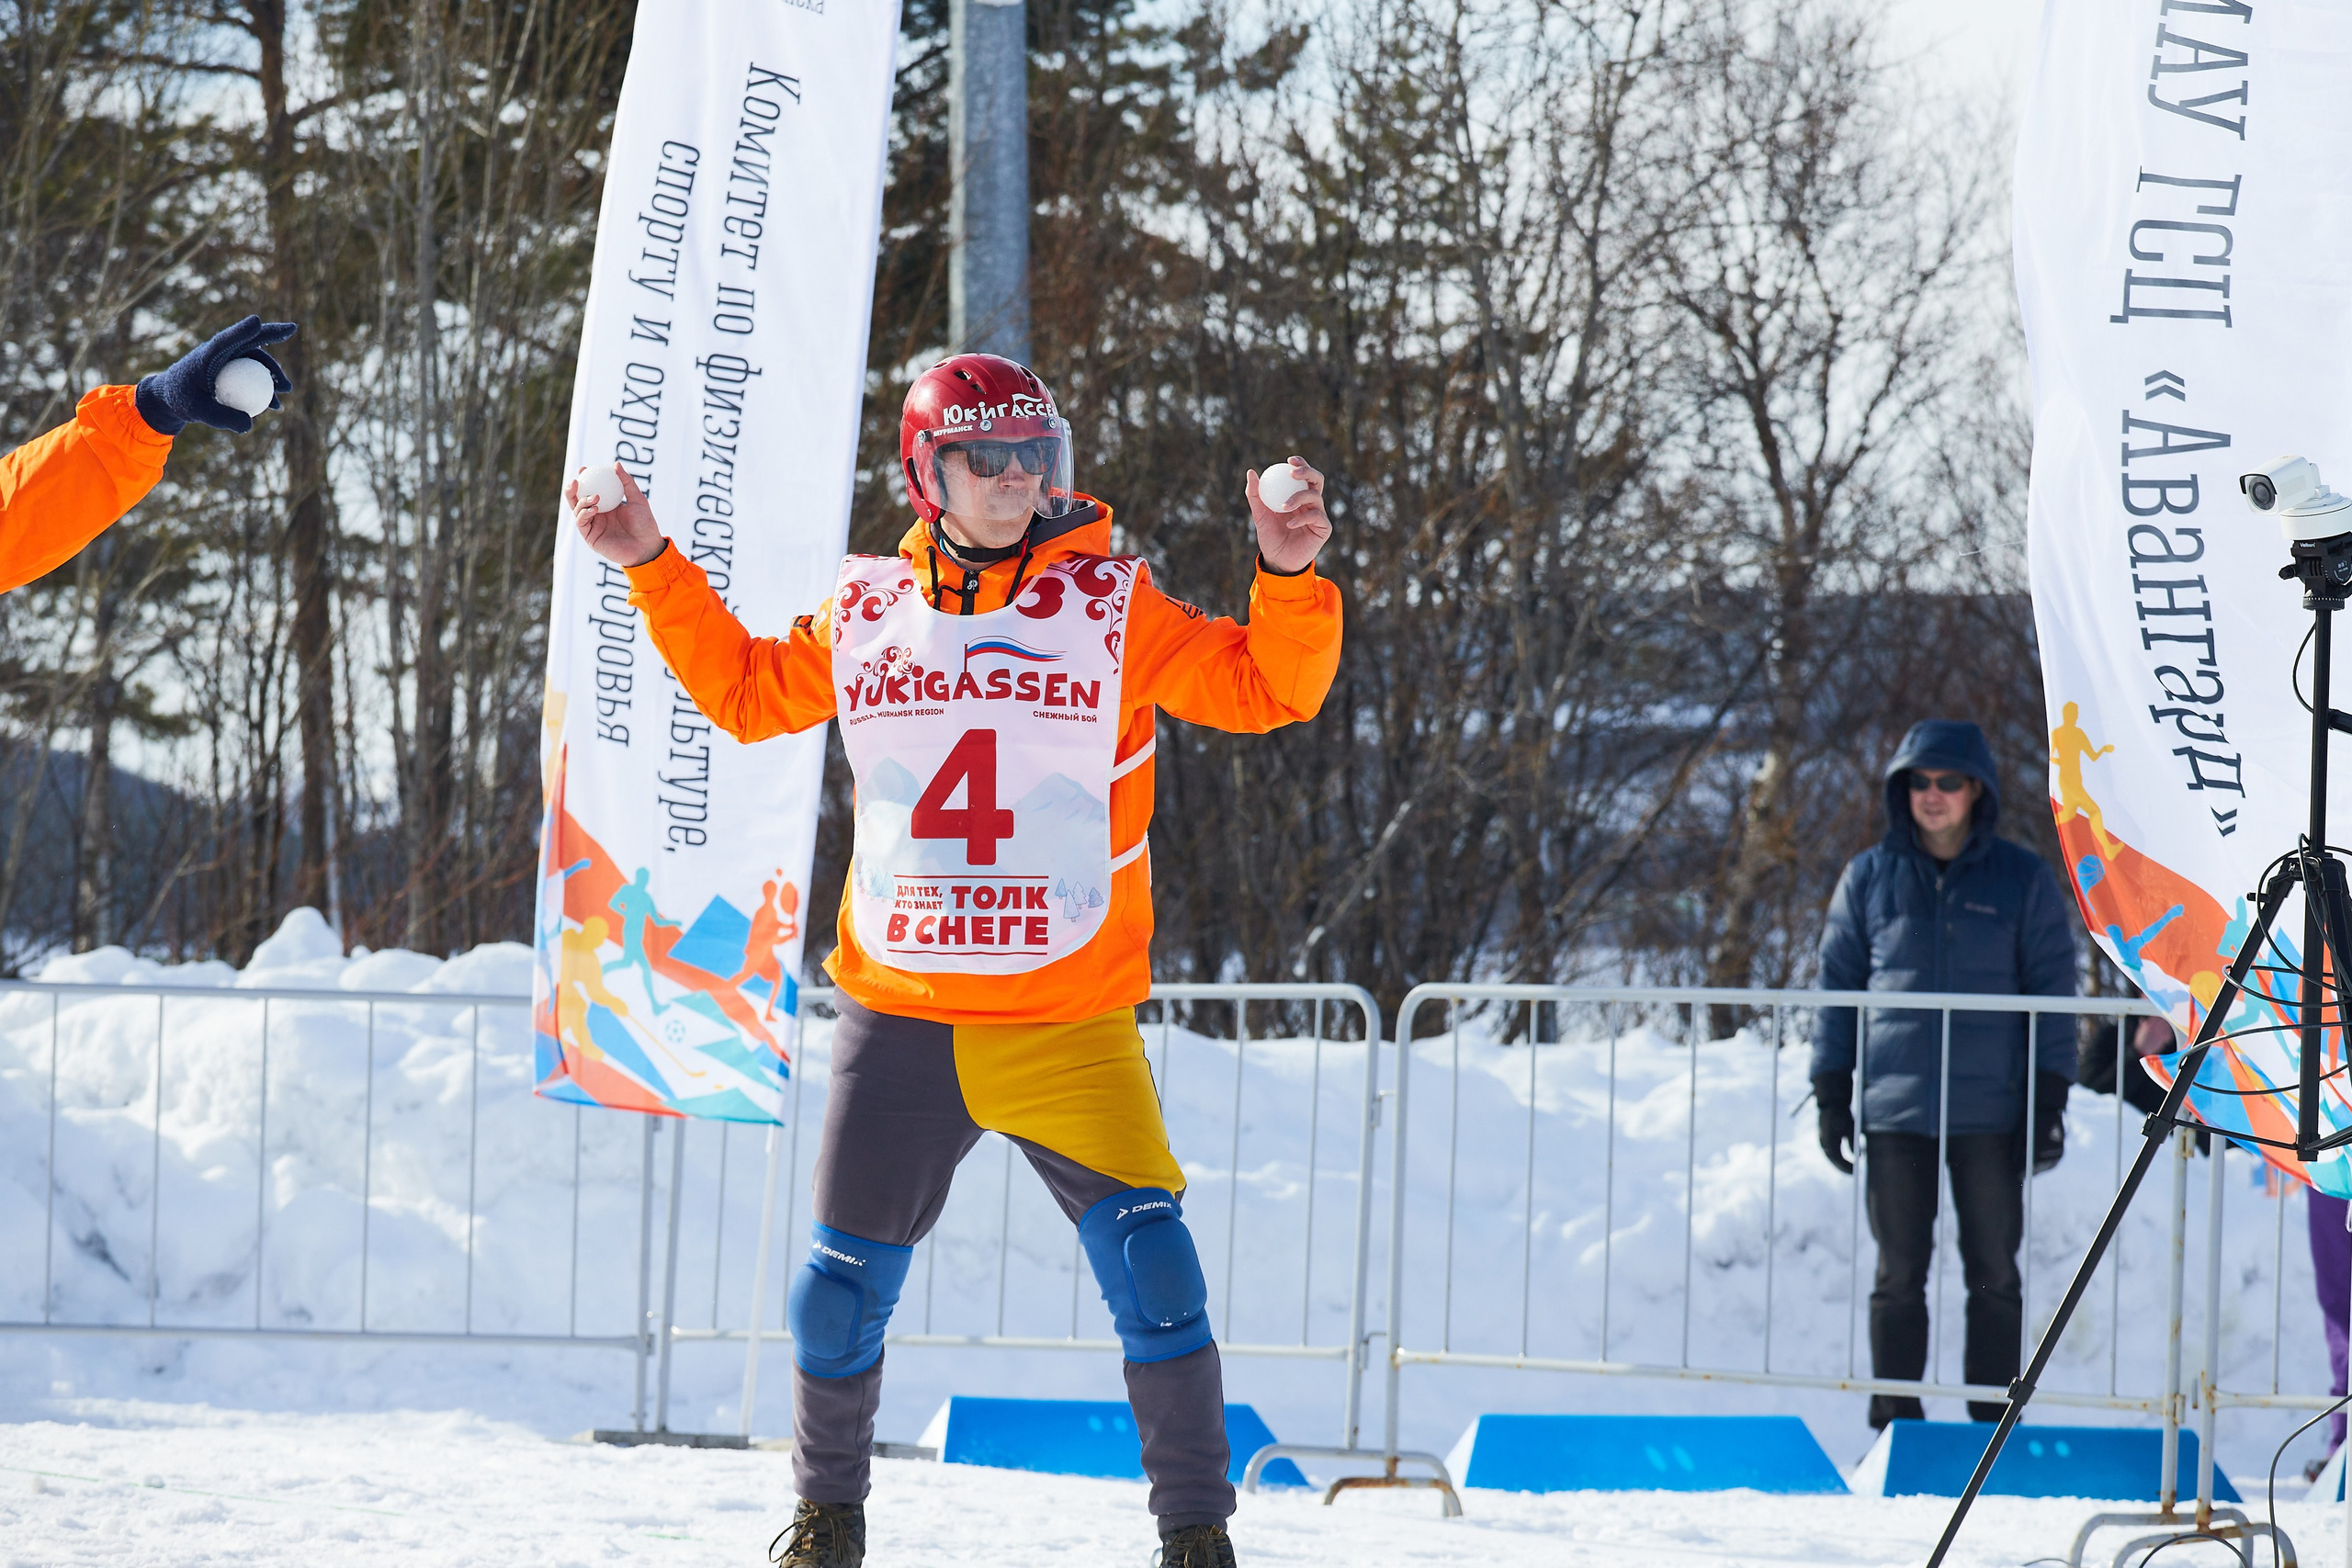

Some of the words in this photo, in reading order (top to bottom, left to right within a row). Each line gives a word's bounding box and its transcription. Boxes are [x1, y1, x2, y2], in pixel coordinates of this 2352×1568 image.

[720, 62, 801, 269] Комитет
[628, 141, 700, 301] спорту
[2109, 165, 2242, 328] ГСЦ
[630, 314, 672, 346] и
[713, 283, 755, 335] по
[610, 362, 664, 504] охра
[933, 425, 974, 437] МУРМАНСК
[689, 354, 762, 618] физическо
[2120, 369, 2246, 838] «Авангард»
[589, 561, 638, 748] доровья
[850, 714, 876, 726] RUSSIA,
[877, 709, 913, 717] MURMANSK
[915, 708, 944, 716] REGION
[1033, 711, 1080, 722] СНЕЖНЫЙ
[1081, 715, 1098, 723] БОЙ
[658, 667, 711, 852] льтуре,
[910, 728, 1014, 866] 4
[895, 900, 913, 909] КТО
[914, 901, 944, 910] ЗНАЕТ
[897, 886, 915, 897] ДЛЯ
[917, 886, 943, 898] ТЕХ,
[951, 886, 1049, 910] ТОЛК
[887, 913, 910, 942] В
[914, 915, 1049, 946] СНЕГЕ
[1132, 1201, 1172, 1213] DEMIX
